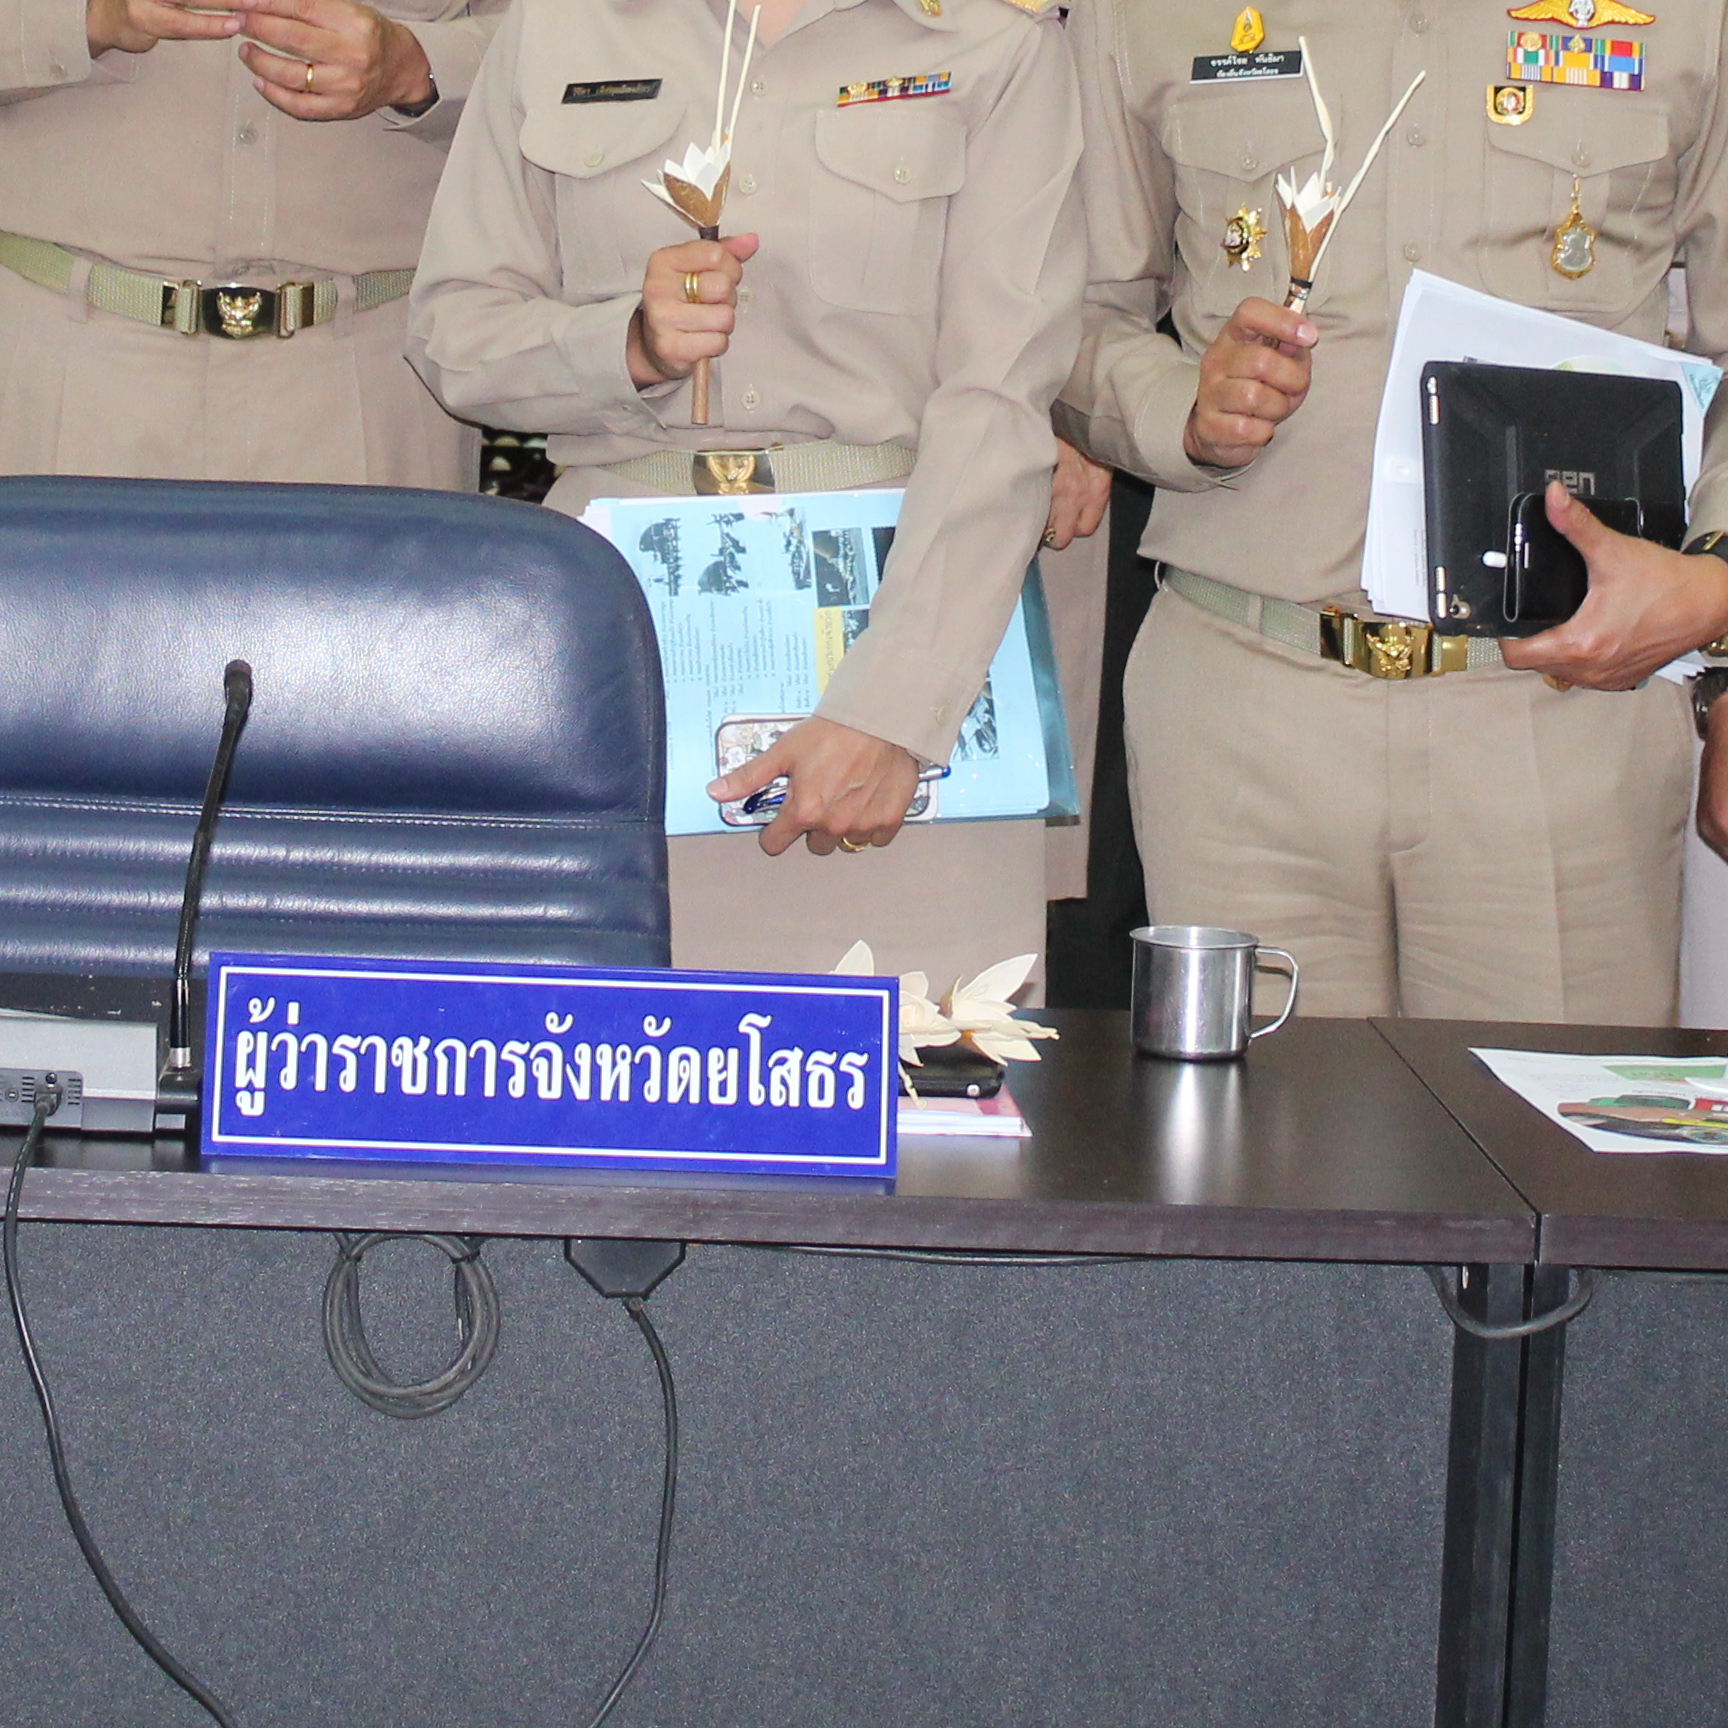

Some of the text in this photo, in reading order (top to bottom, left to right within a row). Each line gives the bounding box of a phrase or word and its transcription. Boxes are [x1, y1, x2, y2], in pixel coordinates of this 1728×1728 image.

[234, 997, 870, 1117] ผู้ว่าราชการจังหวัดยโสธร
